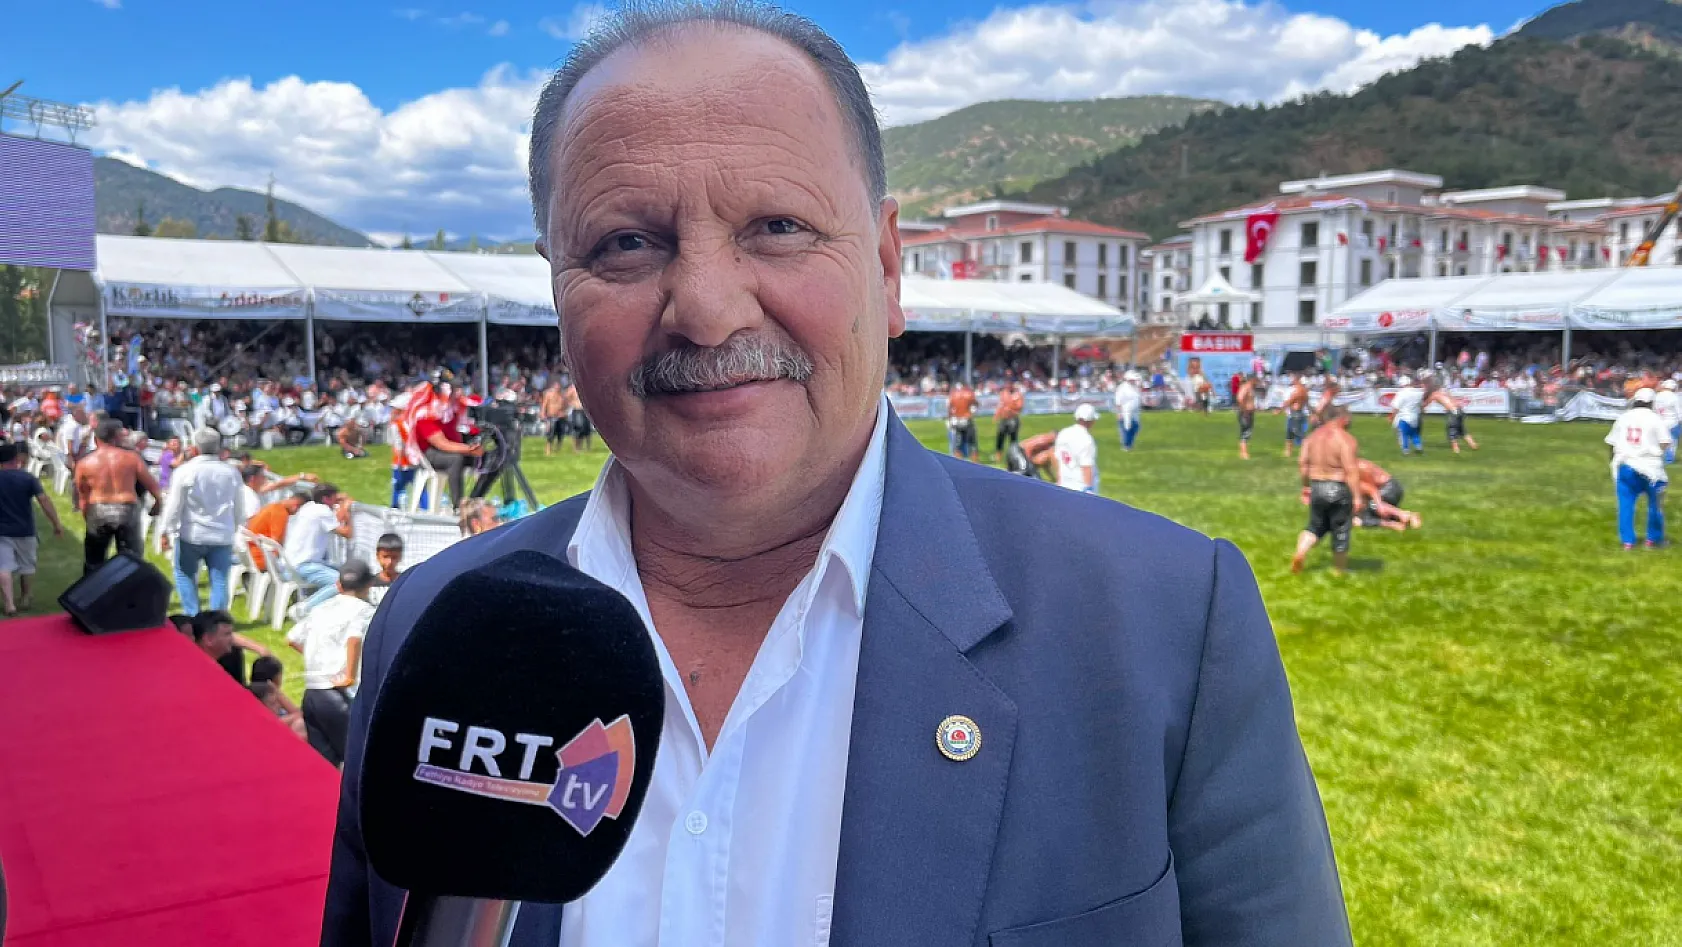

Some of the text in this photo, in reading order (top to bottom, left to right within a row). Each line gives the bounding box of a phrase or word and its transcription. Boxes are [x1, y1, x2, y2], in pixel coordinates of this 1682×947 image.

[1192, 336, 1243, 350] BASIN
[418, 717, 554, 780] FRT
[455, 775, 484, 788] Radyo
[562, 773, 608, 811] tv
